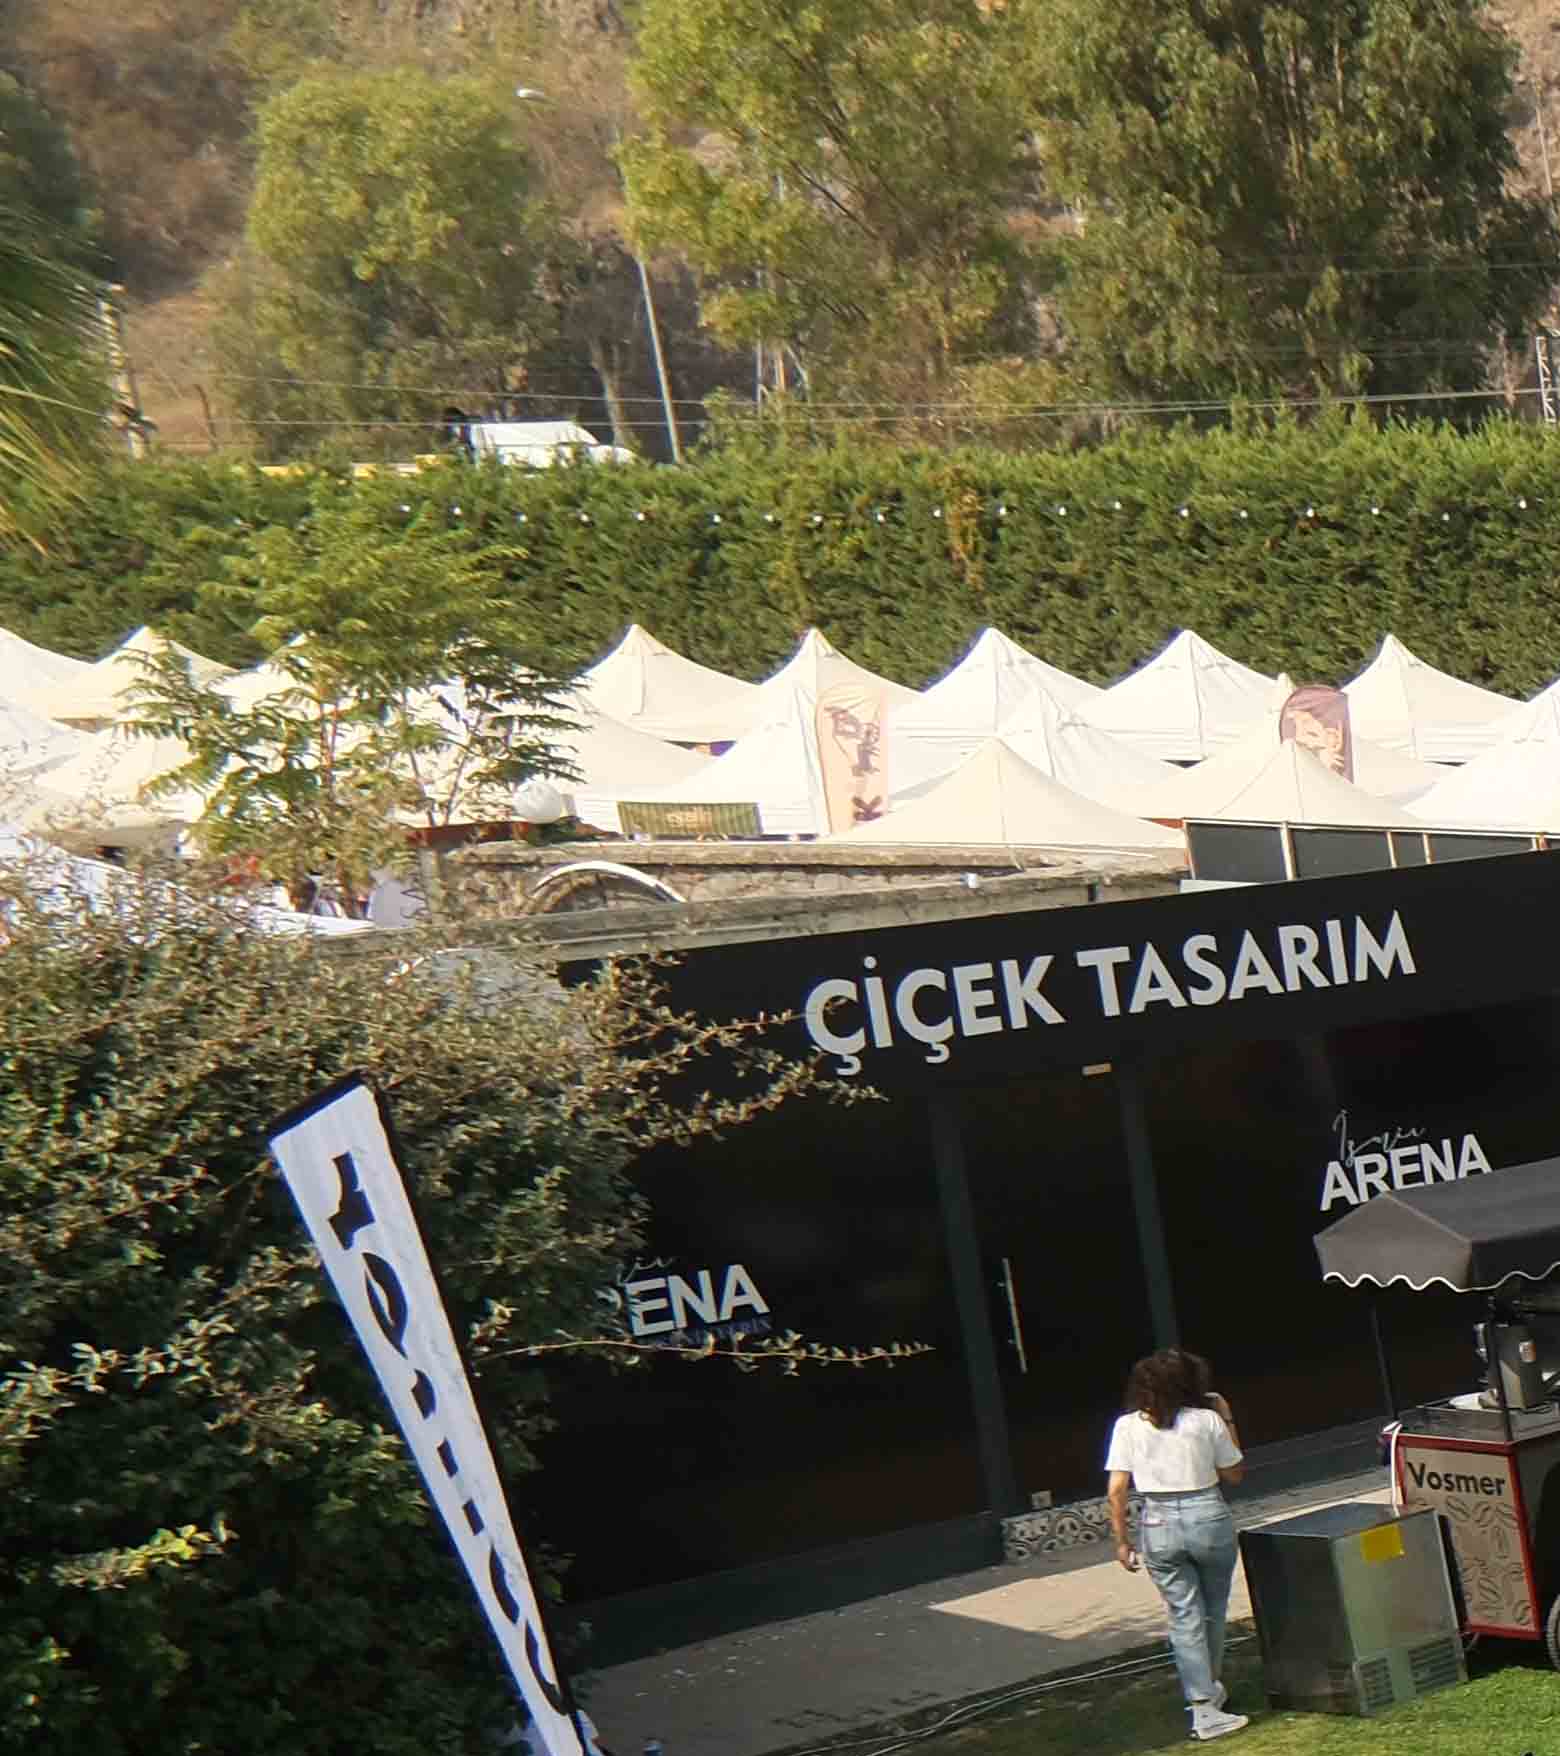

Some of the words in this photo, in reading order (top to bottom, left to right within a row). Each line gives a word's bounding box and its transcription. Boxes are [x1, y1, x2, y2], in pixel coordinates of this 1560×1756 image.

[805, 955, 1066, 1076] ÇİÇEK
[1076, 909, 1417, 1018] TASARIM
[1319, 1133, 1493, 1212] ARENA
[624, 1263, 771, 1337] ENA
[1406, 1461, 1506, 1497] Vosmer
